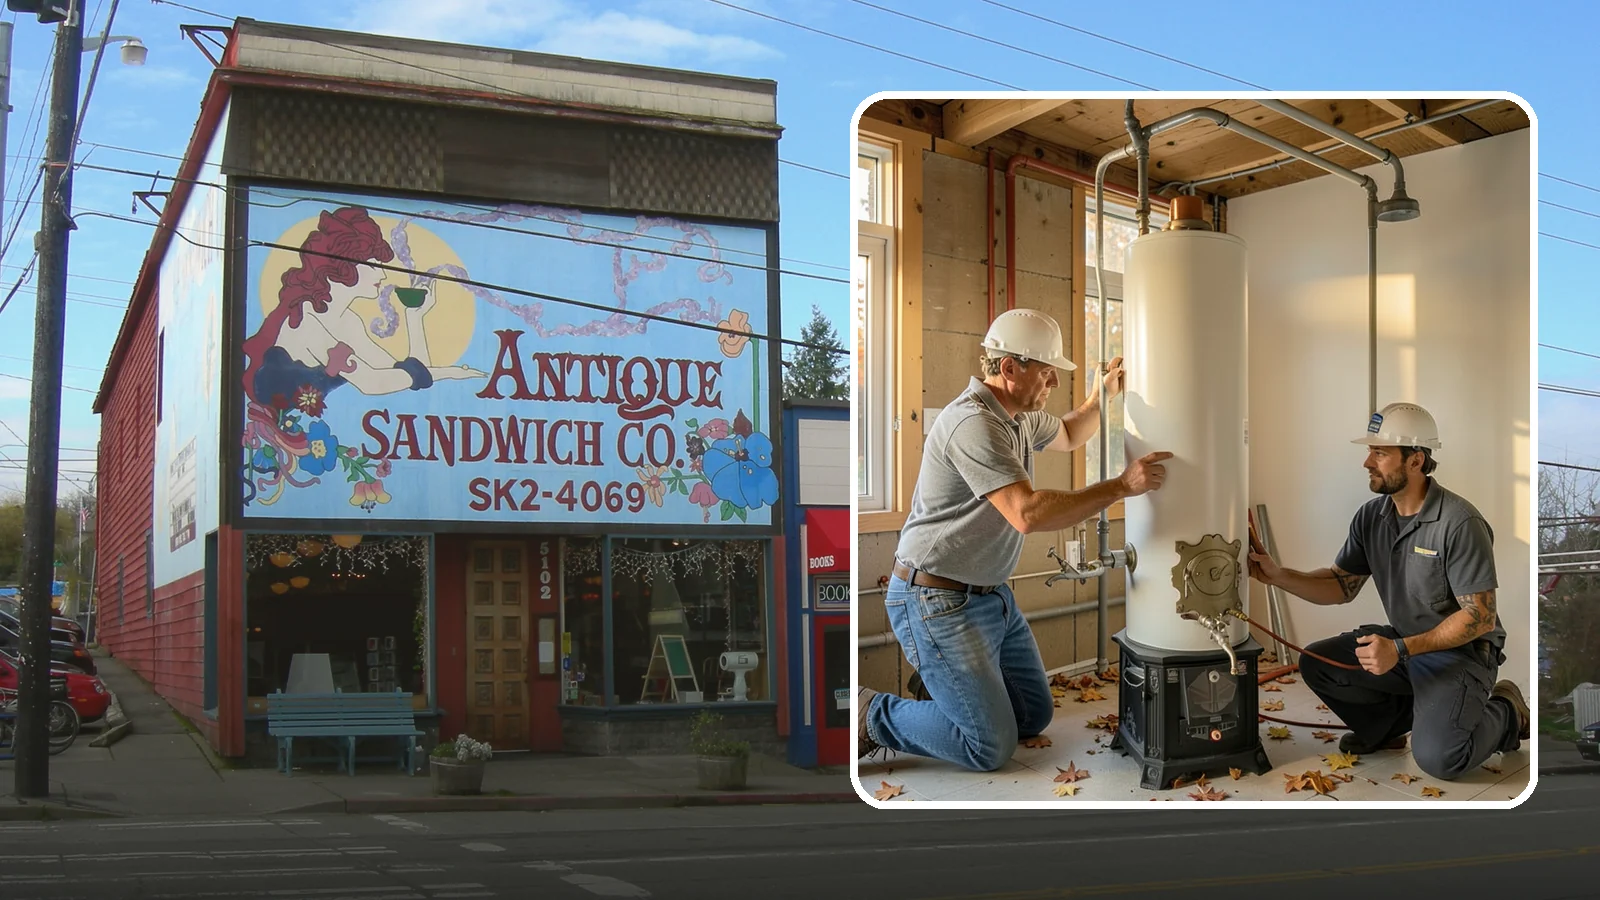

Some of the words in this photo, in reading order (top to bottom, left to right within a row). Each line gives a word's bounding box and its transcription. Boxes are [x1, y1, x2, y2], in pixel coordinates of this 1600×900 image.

[476, 329, 723, 420] ANTIQUE
[362, 408, 605, 467] SANDWICH
[617, 421, 685, 468] CO.
[468, 477, 646, 512] SK2-4069
[540, 541, 551, 599] 5102
[809, 555, 835, 569] BOOKS
